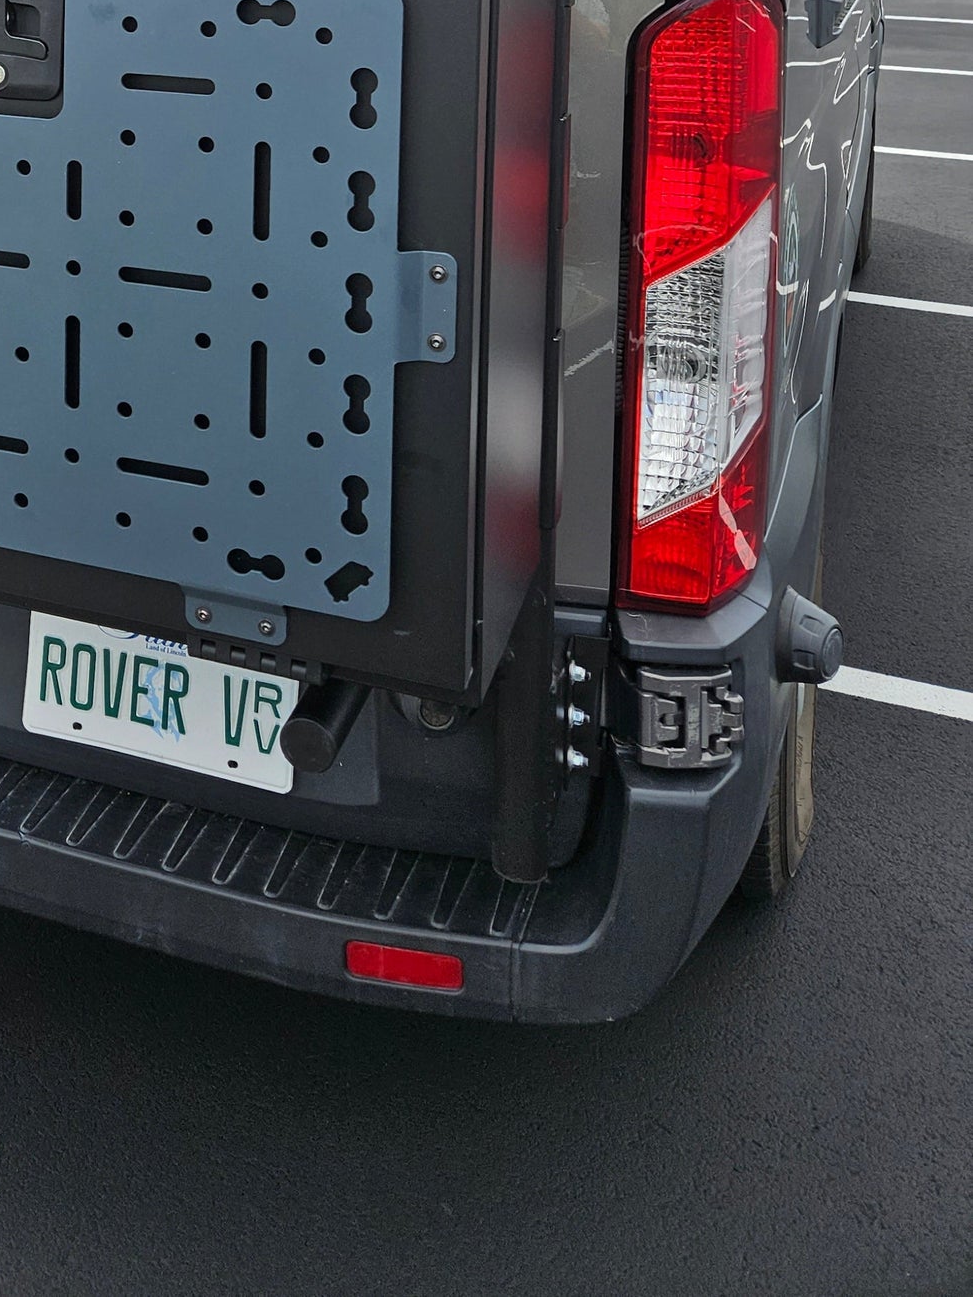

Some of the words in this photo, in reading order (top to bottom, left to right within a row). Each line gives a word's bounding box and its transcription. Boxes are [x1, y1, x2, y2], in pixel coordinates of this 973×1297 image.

[145, 642, 160, 651] Land
[166, 647, 187, 657] Lincoln
[39, 635, 190, 735] ROVER
